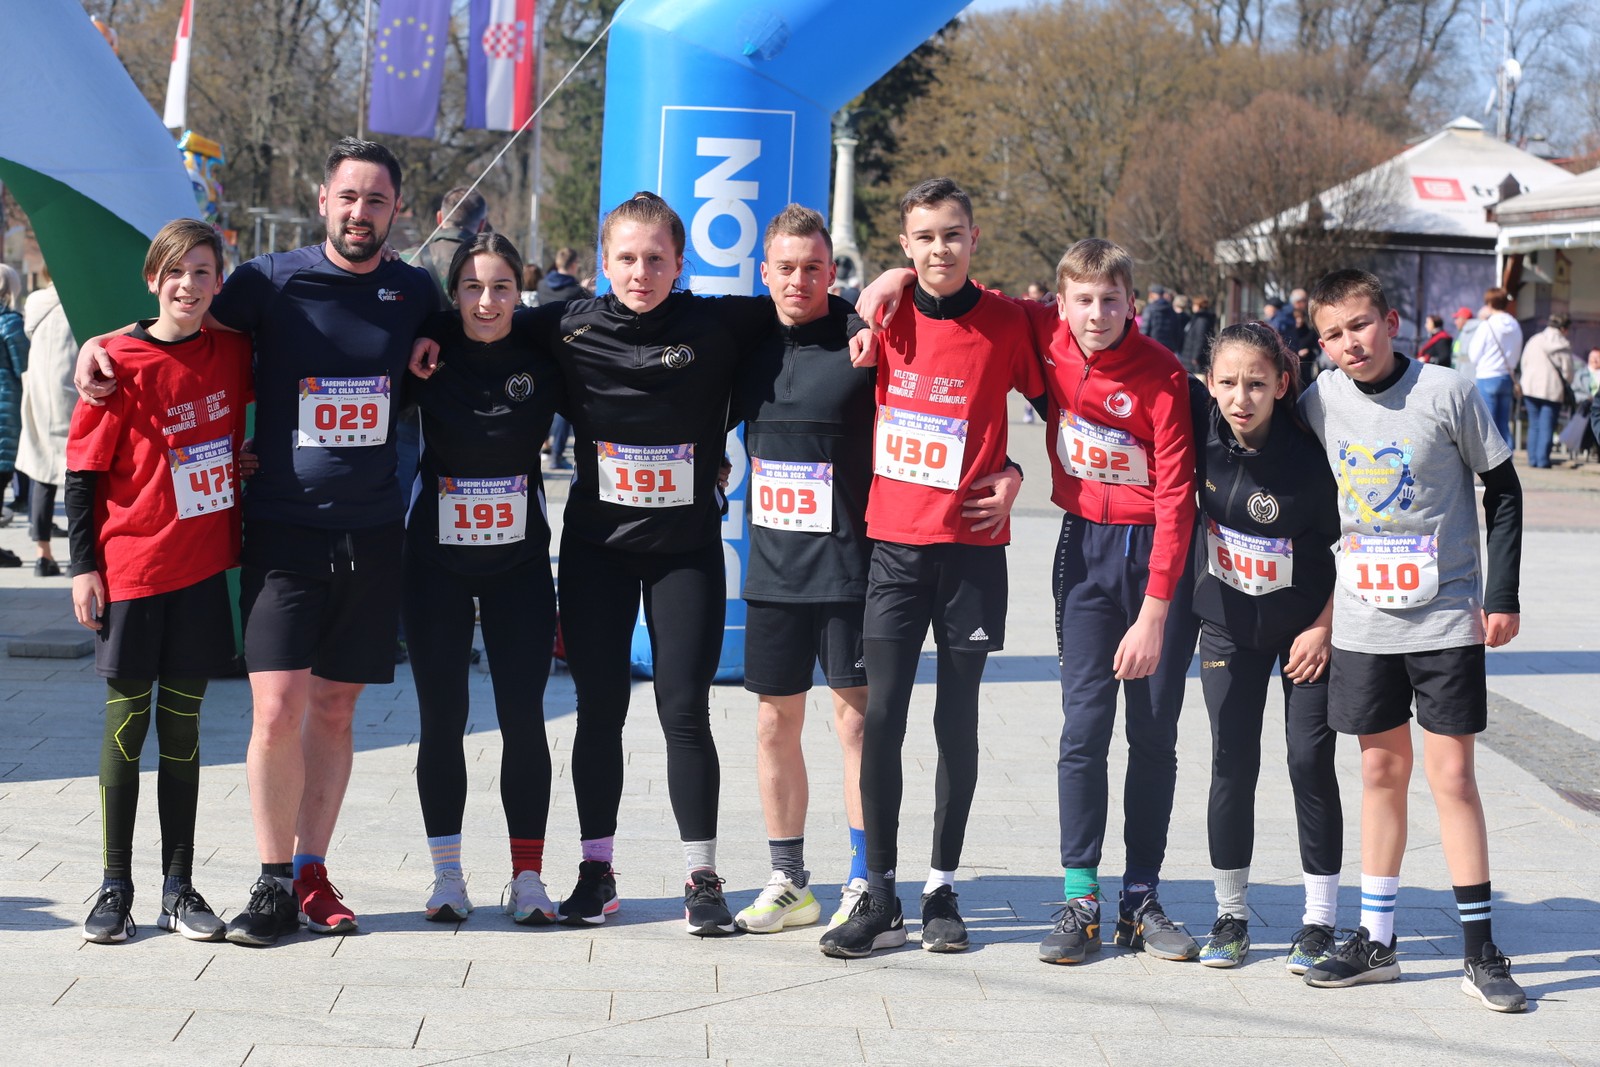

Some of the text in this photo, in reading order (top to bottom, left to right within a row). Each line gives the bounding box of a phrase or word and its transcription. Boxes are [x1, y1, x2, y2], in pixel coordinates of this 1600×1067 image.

[893, 369, 919, 382] ATLETSKI
[901, 380, 917, 389] KLUB
[933, 376, 965, 388] ATHLETIC
[931, 385, 949, 395] CLUB
[167, 401, 194, 417] ATLETSKI
[180, 411, 196, 422] KLUB
[207, 401, 220, 413] CLUB
[315, 403, 378, 430] 029
[886, 433, 948, 470] 430
[1071, 438, 1130, 471] 192
[615, 467, 676, 492] 191
[760, 485, 817, 514] 003
[454, 503, 514, 529] 193
[1062, 520, 1073, 544] LOOK
[1217, 546, 1277, 582] 644
[1356, 563, 1420, 590] 110
